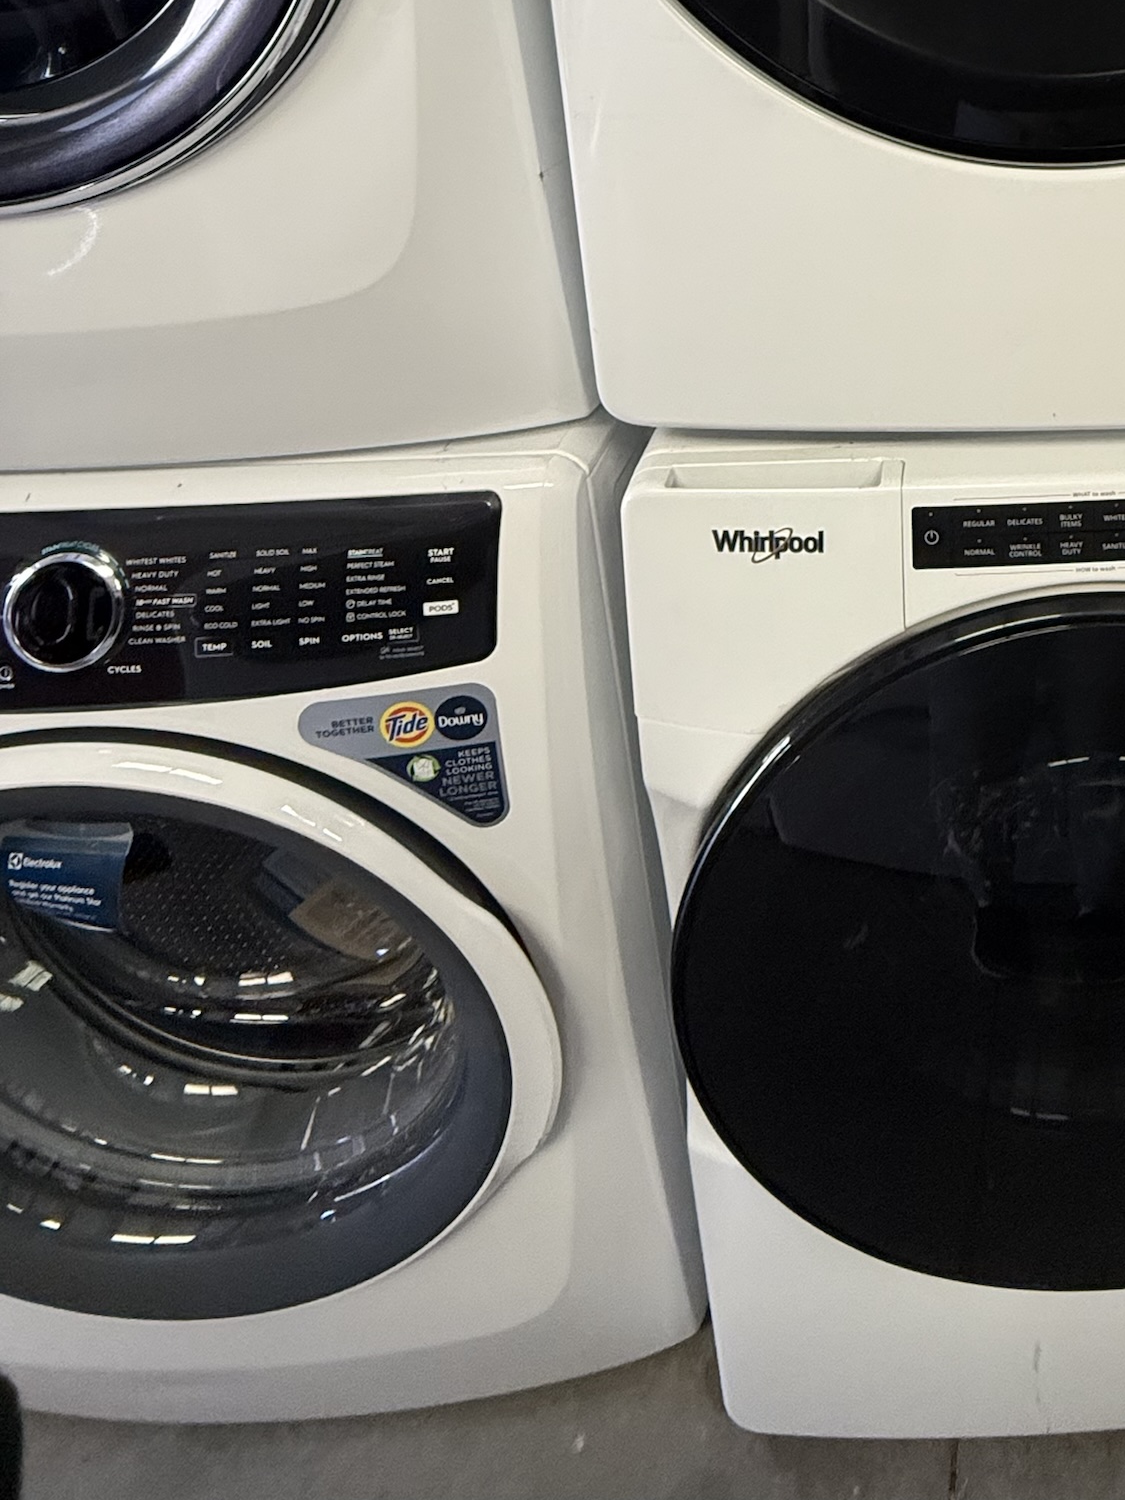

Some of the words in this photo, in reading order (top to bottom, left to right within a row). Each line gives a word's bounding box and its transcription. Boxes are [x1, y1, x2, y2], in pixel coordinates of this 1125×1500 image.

[1007, 518, 1043, 526] DELICATES
[712, 530, 824, 560] Whirlpool
[209, 551, 237, 559] SANITIZE
[428, 548, 454, 557] START
[159, 556, 186, 564] WHITES
[159, 570, 179, 578] DUTY
[427, 577, 454, 585] CANCEL
[204, 604, 224, 612] COOL
[136, 610, 175, 619] DELICATES
[356, 612, 387, 620] CONTROL
[389, 627, 414, 635] SELECT
[155, 636, 186, 644] WASHER
[299, 637, 320, 645] SPIN
[342, 632, 384, 642] OPTIONS
[202, 643, 227, 651] TEMP
[251, 640, 273, 649] SOIL
[107, 665, 141, 673] CYCLES
[331, 717, 373, 728] BETTER
[438, 712, 484, 728] Downy
[385, 711, 429, 742] Tide
[316, 726, 374, 738] TOGETHER
[458, 747, 491, 757] KEEPS
[445, 755, 491, 767] CLOTHES
[446, 763, 493, 775] LOOKING
[442, 772, 494, 786] NEWER
[439, 782, 497, 797] LONGER
